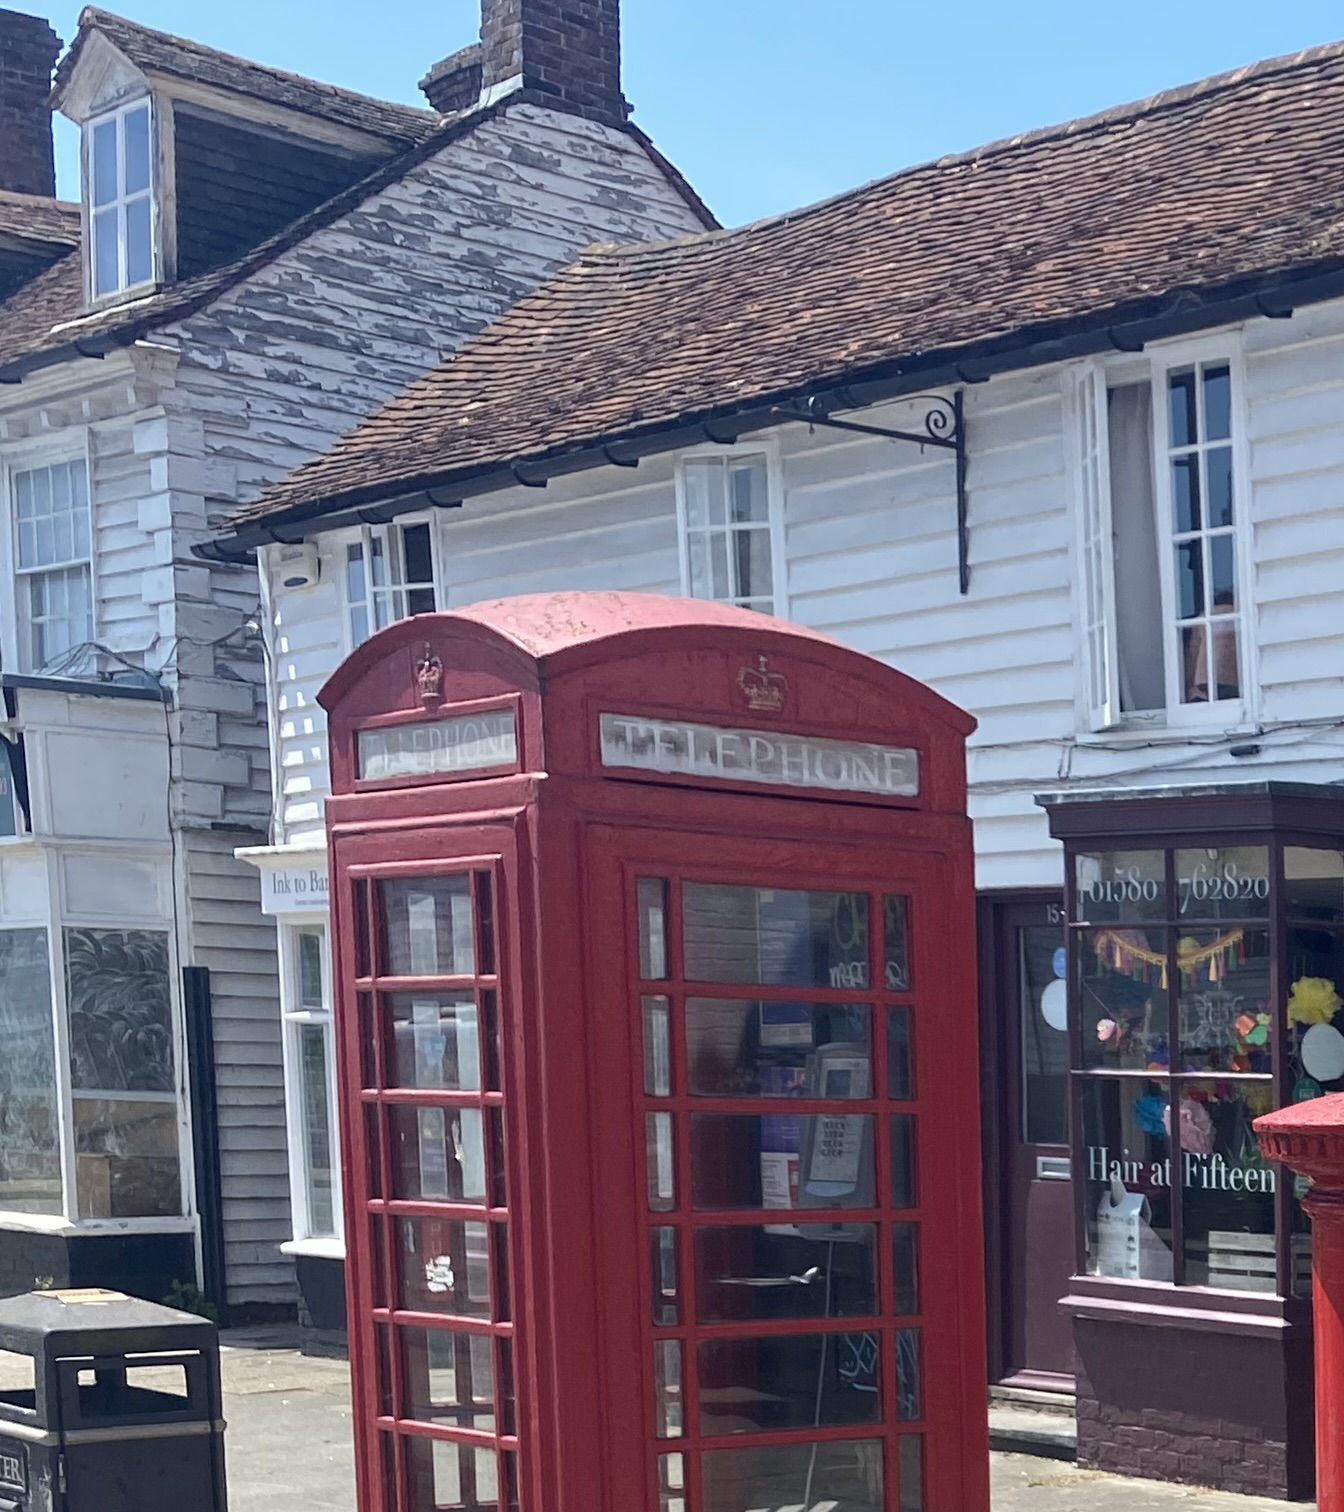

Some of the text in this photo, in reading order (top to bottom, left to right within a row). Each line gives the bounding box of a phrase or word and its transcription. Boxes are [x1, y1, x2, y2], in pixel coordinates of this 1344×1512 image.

[272, 871, 291, 894] Ink
[294, 877, 306, 893] to
[1178, 863, 1269, 914] 762820
[1046, 903, 1060, 924] 15
[1088, 1146, 1276, 1193] Hair at Fifteen
[0, 1456, 23, 1482] ER
